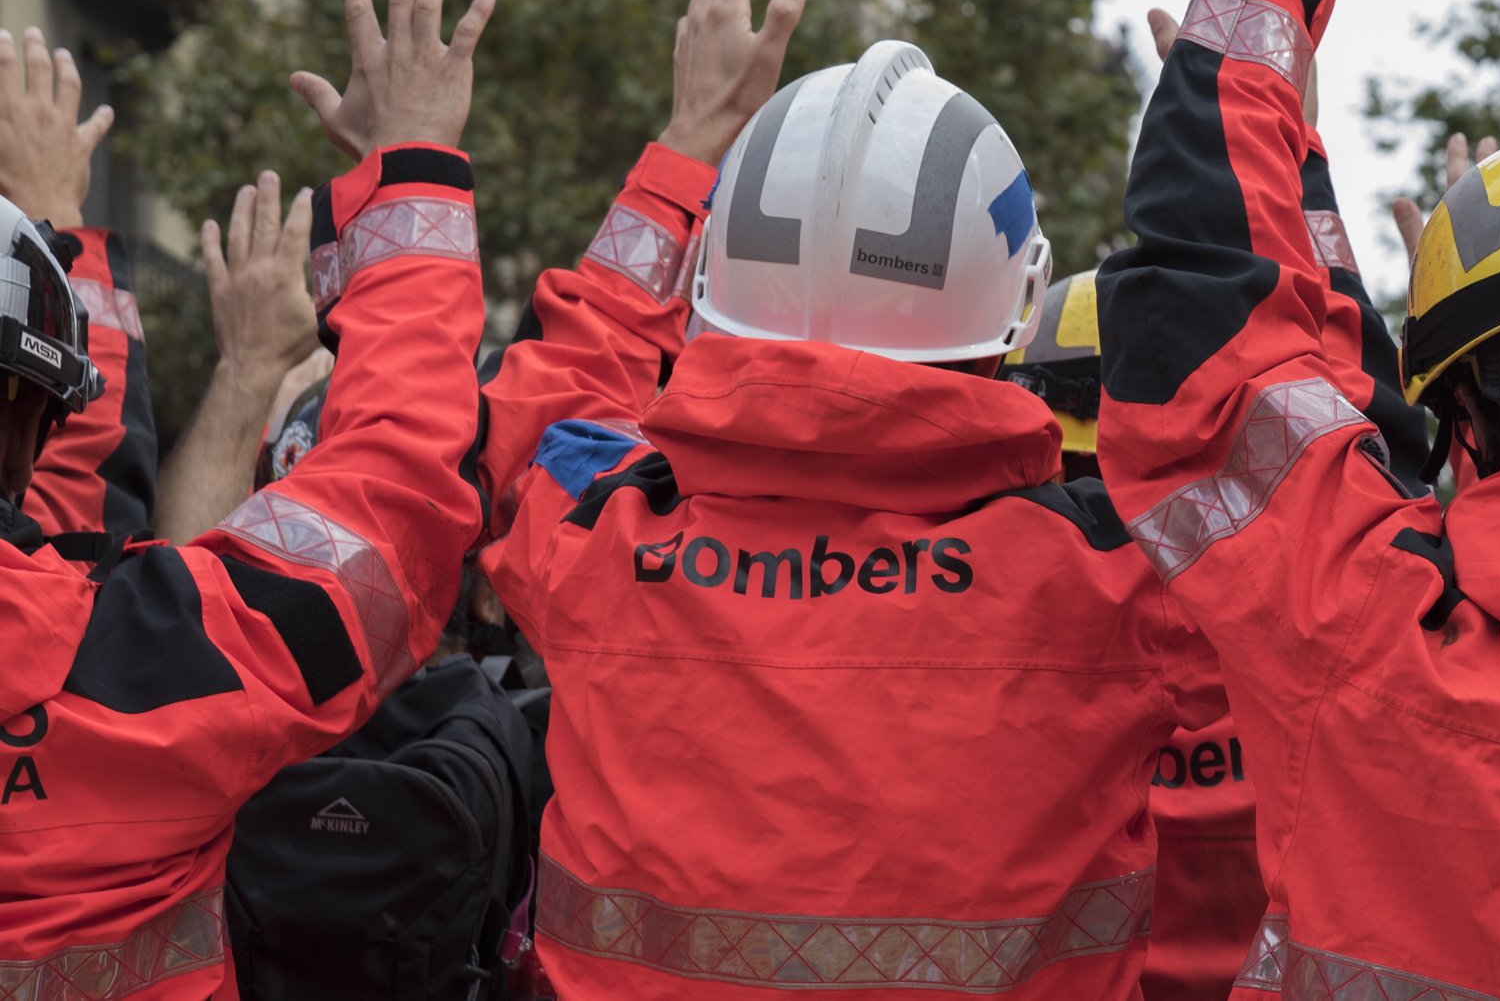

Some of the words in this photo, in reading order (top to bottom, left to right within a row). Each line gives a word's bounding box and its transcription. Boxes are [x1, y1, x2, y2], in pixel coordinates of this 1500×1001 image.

[857, 248, 930, 275] bombers
[24, 337, 60, 365] MSA
[633, 530, 974, 600] Bombers
